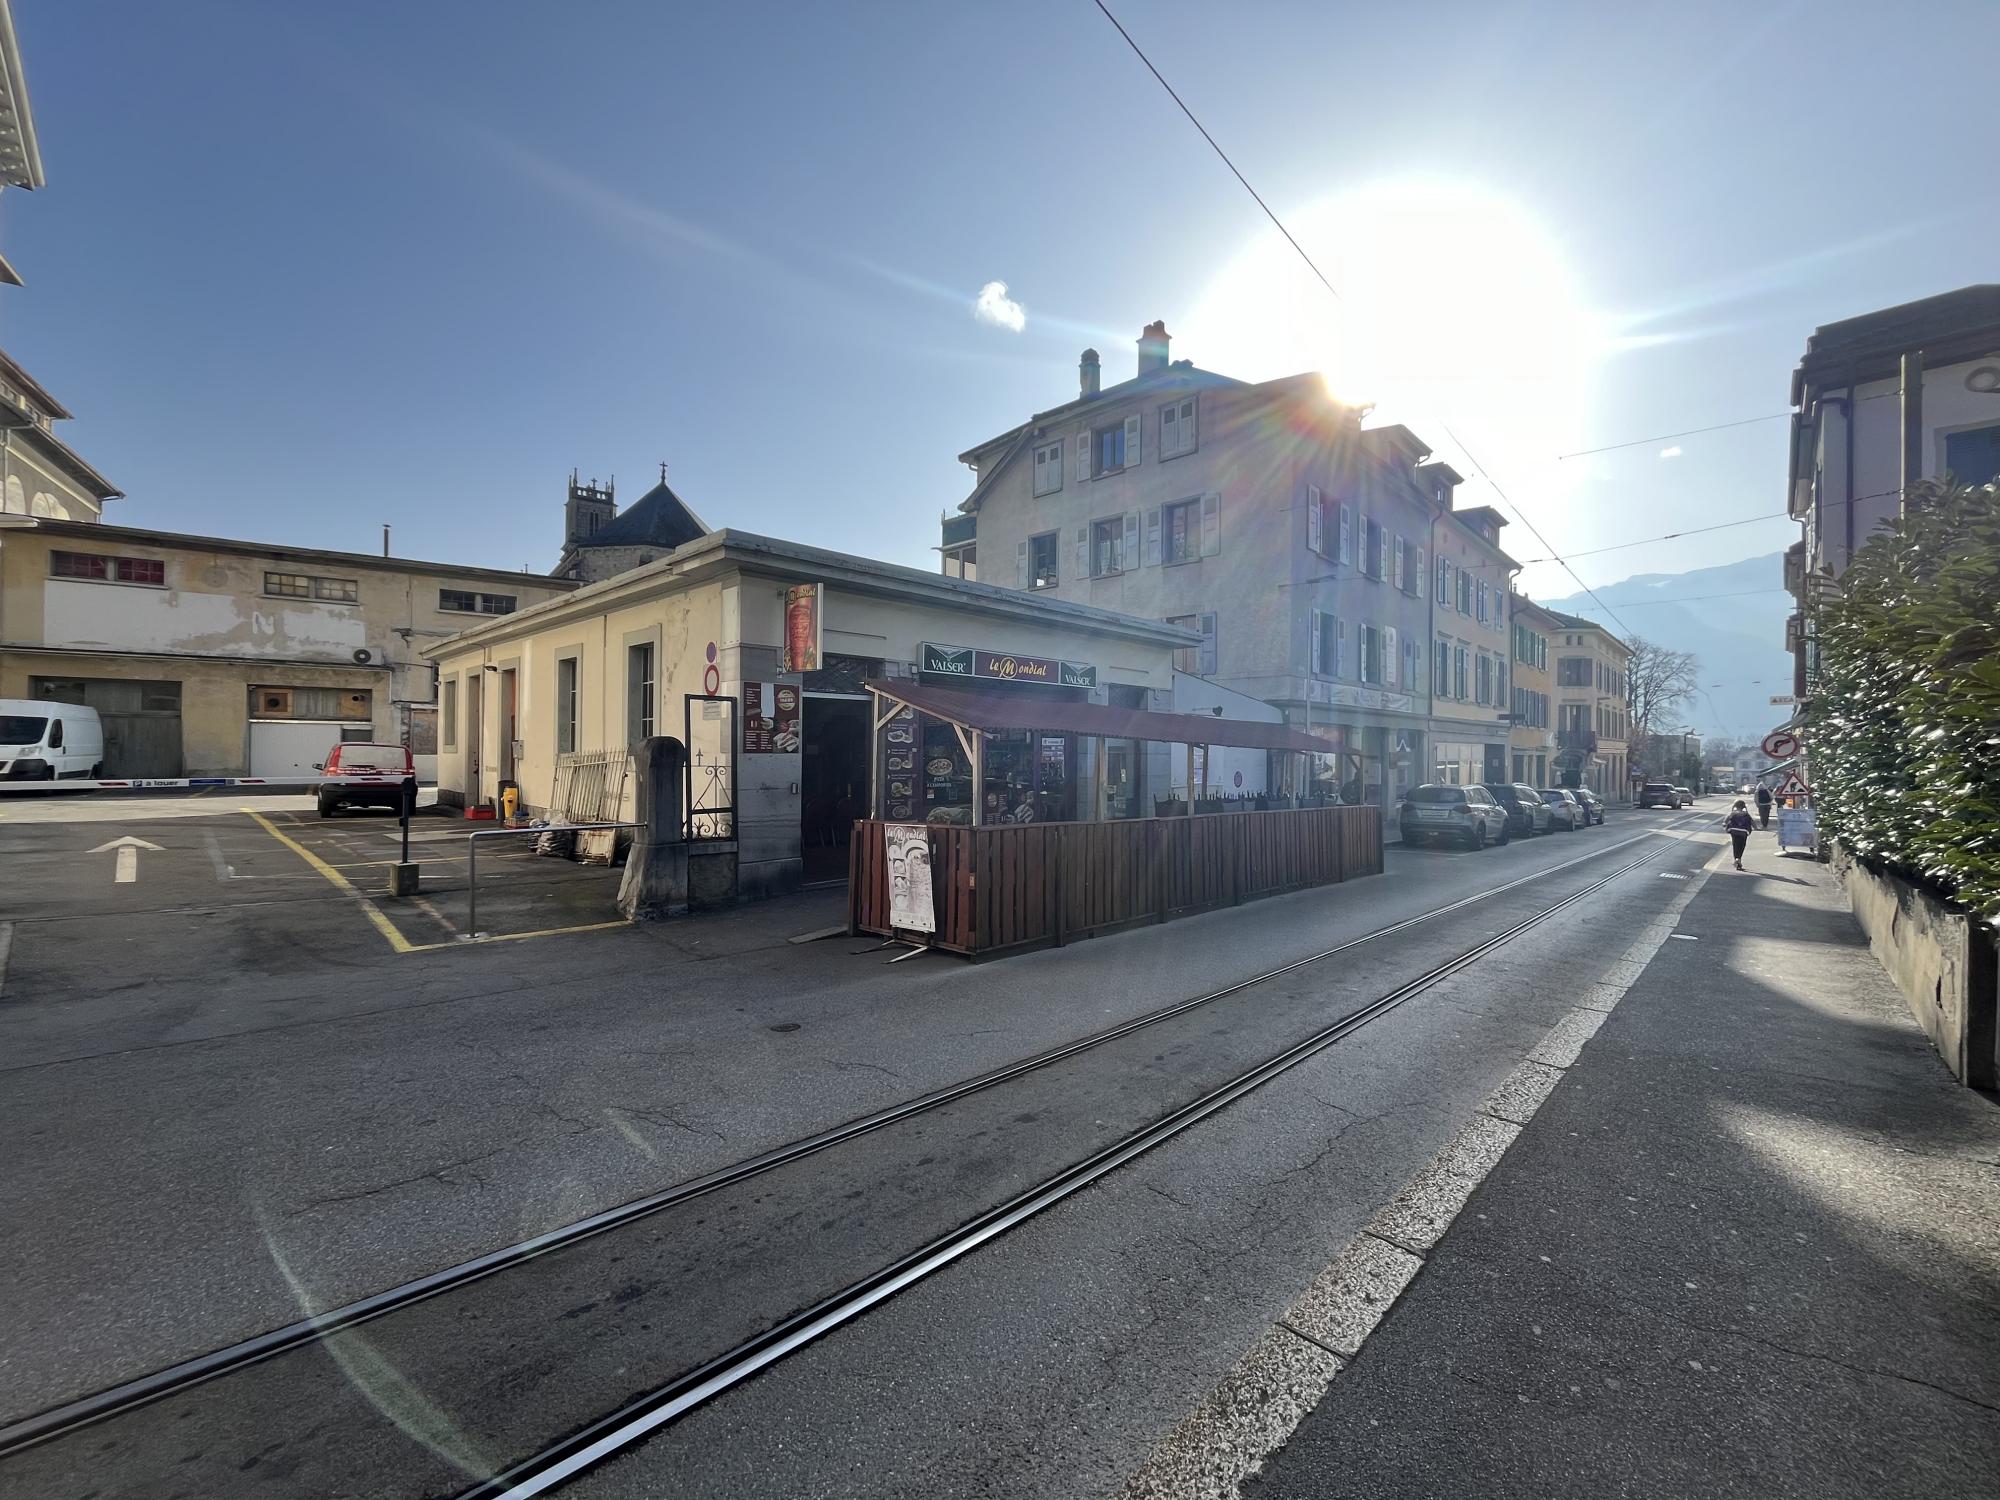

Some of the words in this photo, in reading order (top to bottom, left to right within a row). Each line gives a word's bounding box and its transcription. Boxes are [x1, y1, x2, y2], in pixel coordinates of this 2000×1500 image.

[931, 659, 966, 673] VALSER
[989, 658, 1000, 671] le
[999, 657, 1047, 679] Mondial
[1064, 674, 1092, 686] VALSER
